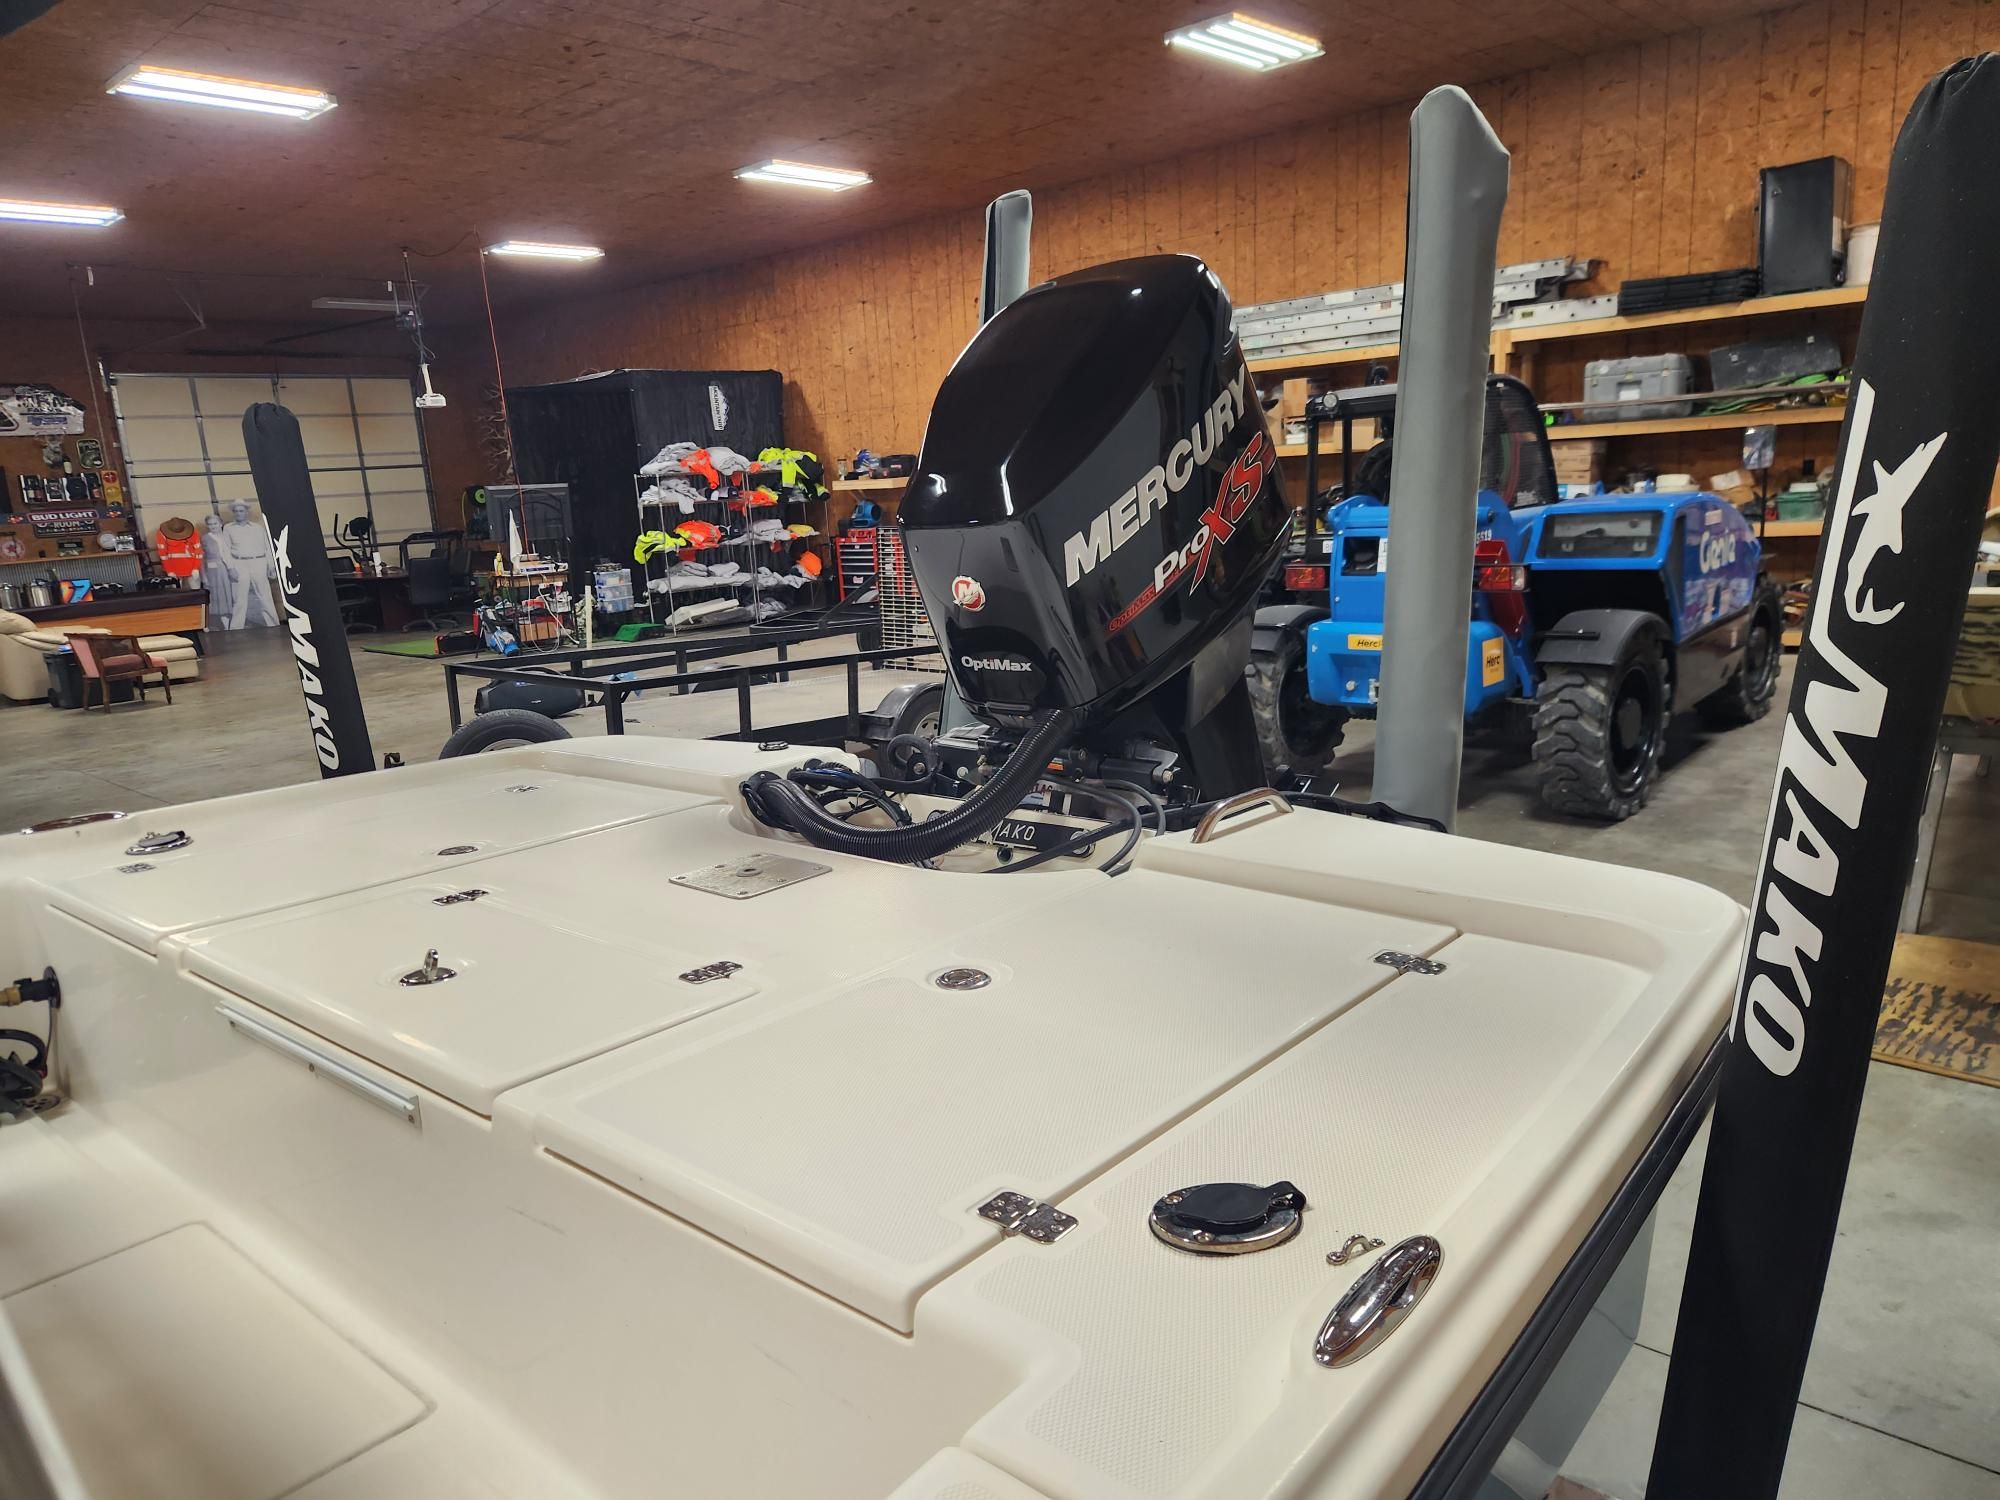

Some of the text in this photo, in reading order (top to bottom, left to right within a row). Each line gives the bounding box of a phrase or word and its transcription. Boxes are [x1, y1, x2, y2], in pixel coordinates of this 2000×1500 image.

[31, 511, 94, 521] BUD LIGHT
[1064, 363, 1245, 588] MERCURY
[1700, 528, 1735, 574] Genie
[284, 602, 340, 771] MAKO
[961, 656, 1032, 672] OptiMax
[1744, 636, 1888, 1077] MAKO
